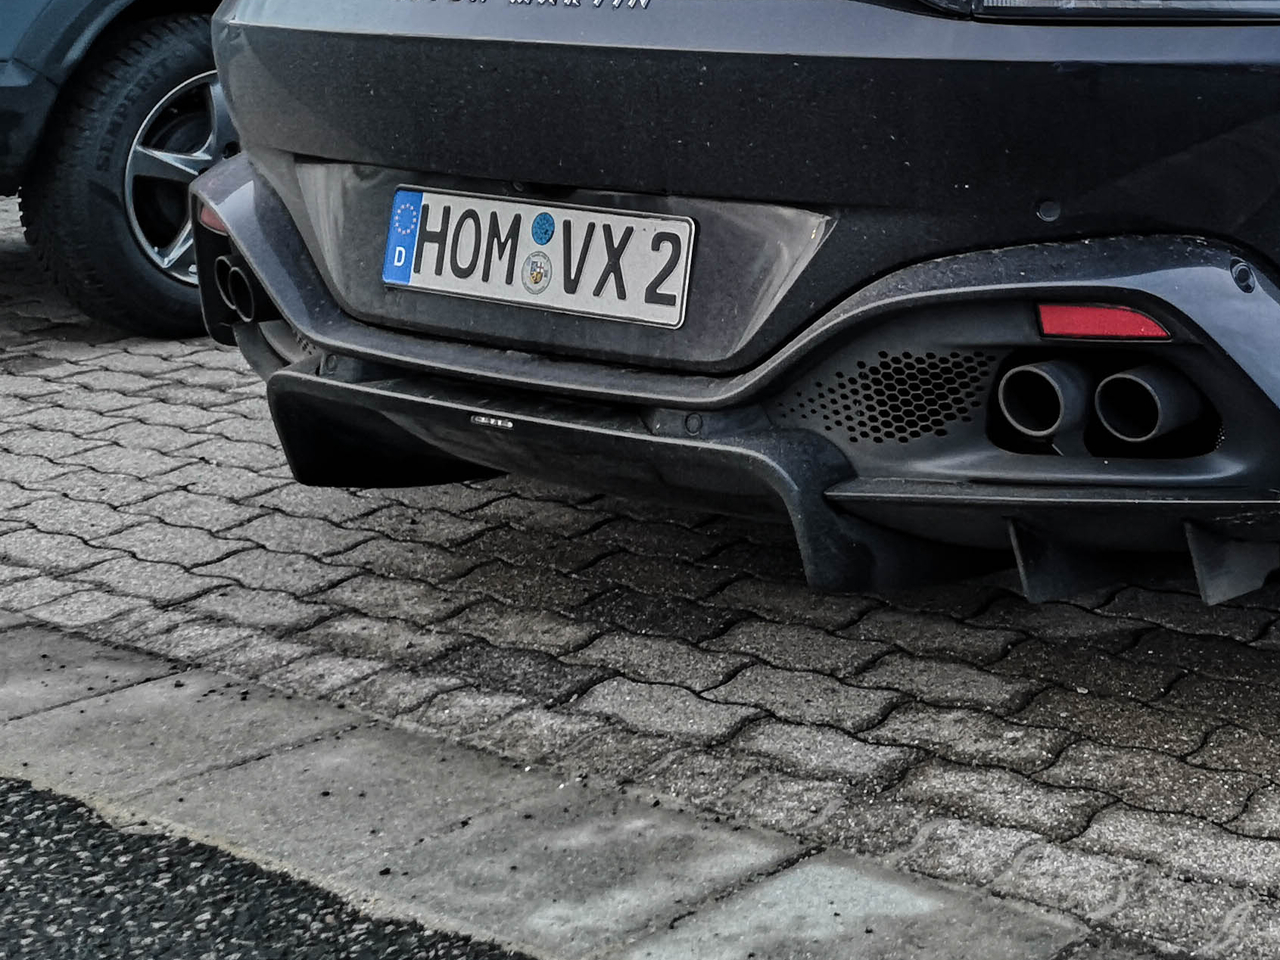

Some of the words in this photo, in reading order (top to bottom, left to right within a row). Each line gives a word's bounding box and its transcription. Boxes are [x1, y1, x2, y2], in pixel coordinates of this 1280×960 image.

[393, 246, 406, 267] D
[413, 203, 522, 286] HOM
[562, 219, 635, 301] VX
[644, 232, 682, 307] 2
